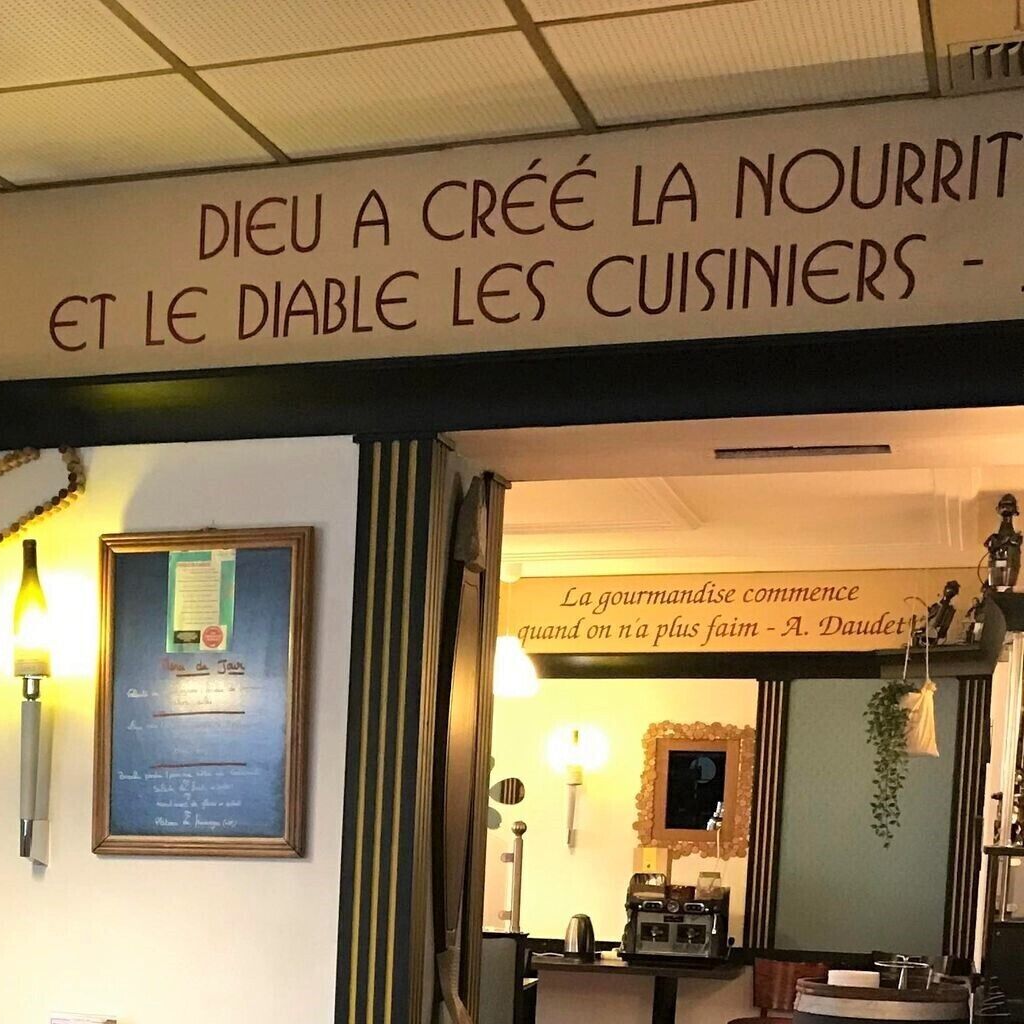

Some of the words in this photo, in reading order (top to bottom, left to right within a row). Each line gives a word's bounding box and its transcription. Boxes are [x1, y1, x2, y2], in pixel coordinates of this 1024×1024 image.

[198, 193, 323, 261] DIEU
[352, 188, 391, 249] A
[421, 154, 598, 241] CRÉÉ
[631, 161, 698, 227] LA
[735, 130, 1024, 219] NOURRIT
[49, 292, 117, 353] ET
[144, 286, 209, 346] LE
[237, 269, 420, 341] DIABLE
[451, 259, 555, 327] LES
[585, 233, 927, 318] CUISINIERS
[517, 616, 585, 648] quand
[587, 626, 612, 640] on
[618, 617, 649, 640] n'a
[652, 615, 700, 648] plus
[700, 613, 759, 647] faim
[780, 615, 809, 638] A.
[818, 611, 907, 636] Daudet
[559, 586, 592, 607] La
[592, 581, 736, 615] gourmandise
[742, 584, 861, 604] commence
